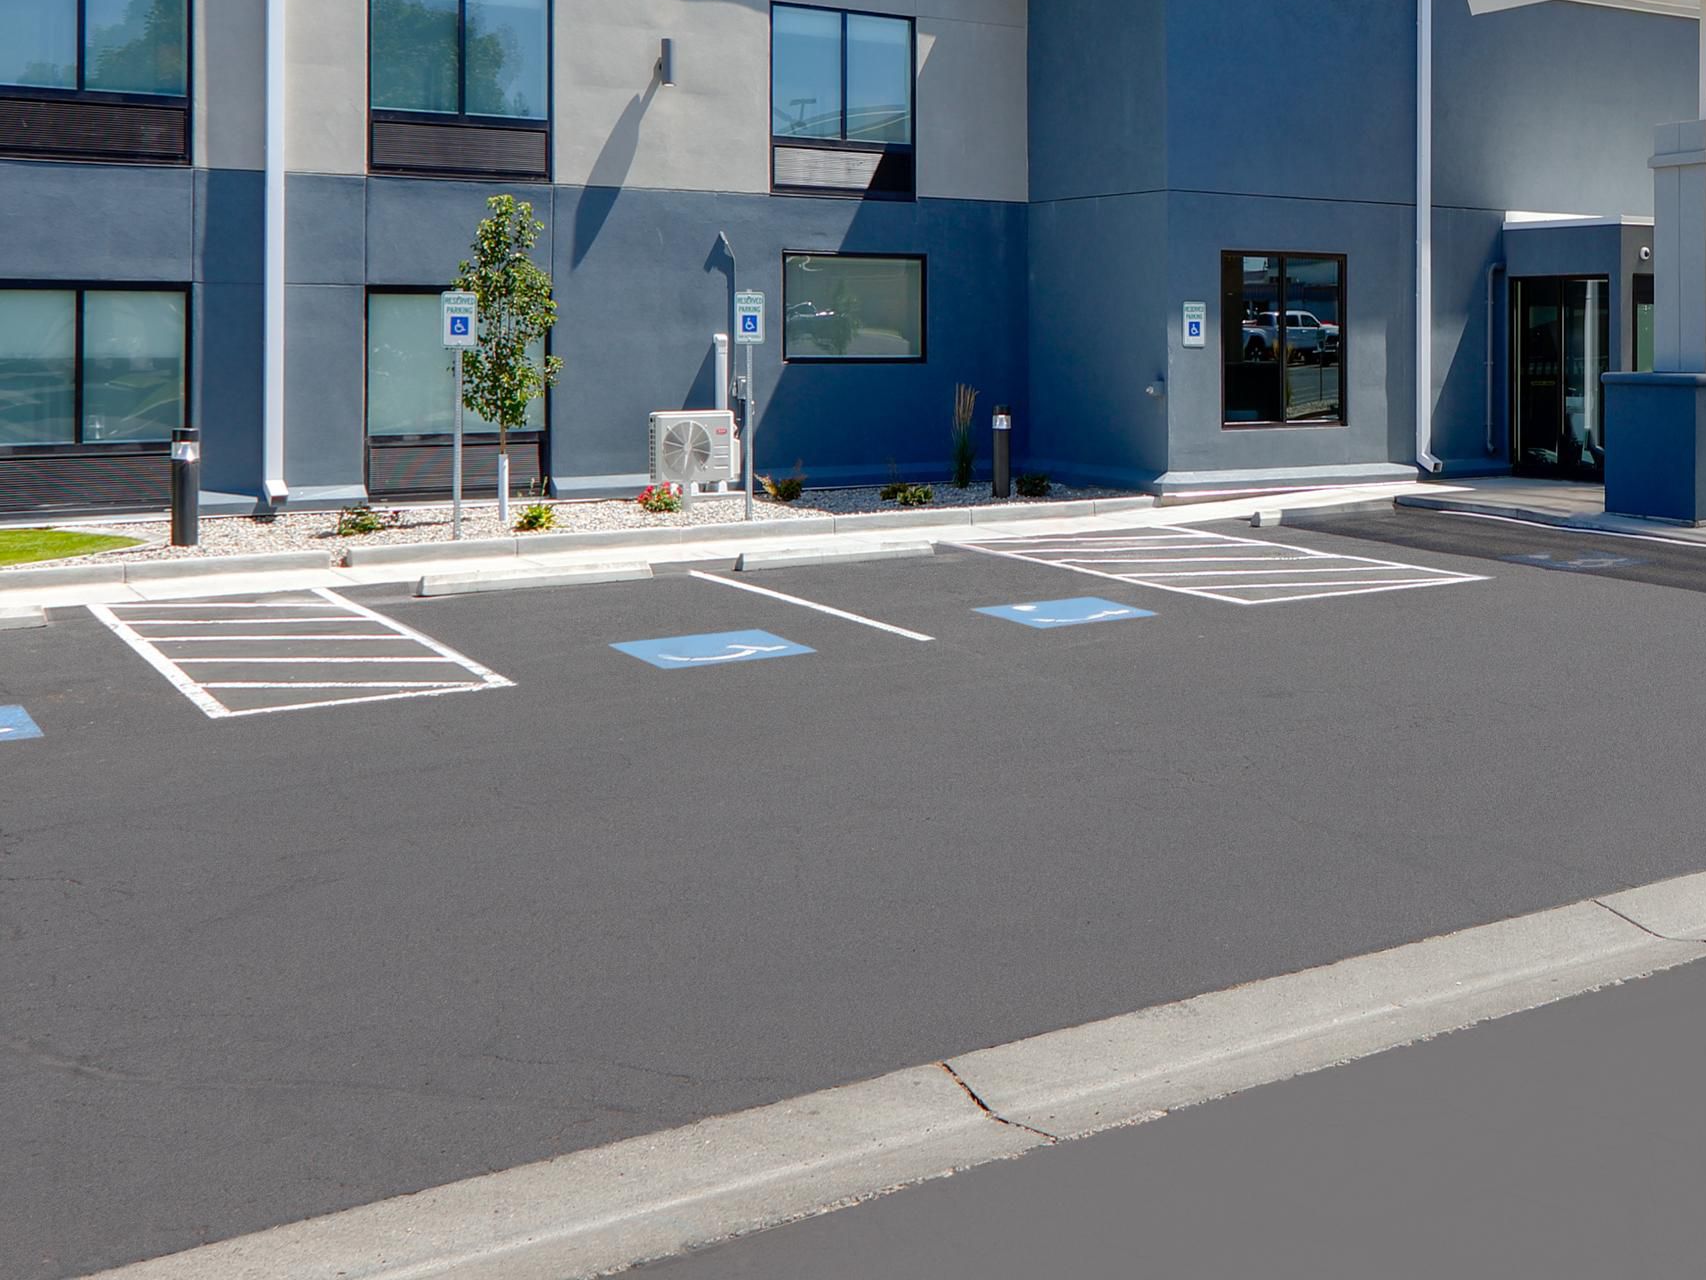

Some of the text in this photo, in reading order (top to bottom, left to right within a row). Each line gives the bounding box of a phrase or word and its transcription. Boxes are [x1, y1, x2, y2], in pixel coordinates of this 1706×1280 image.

[444, 296, 476, 305] RESERVED
[736, 296, 764, 305] RESERVED
[446, 306, 474, 315] PARKING
